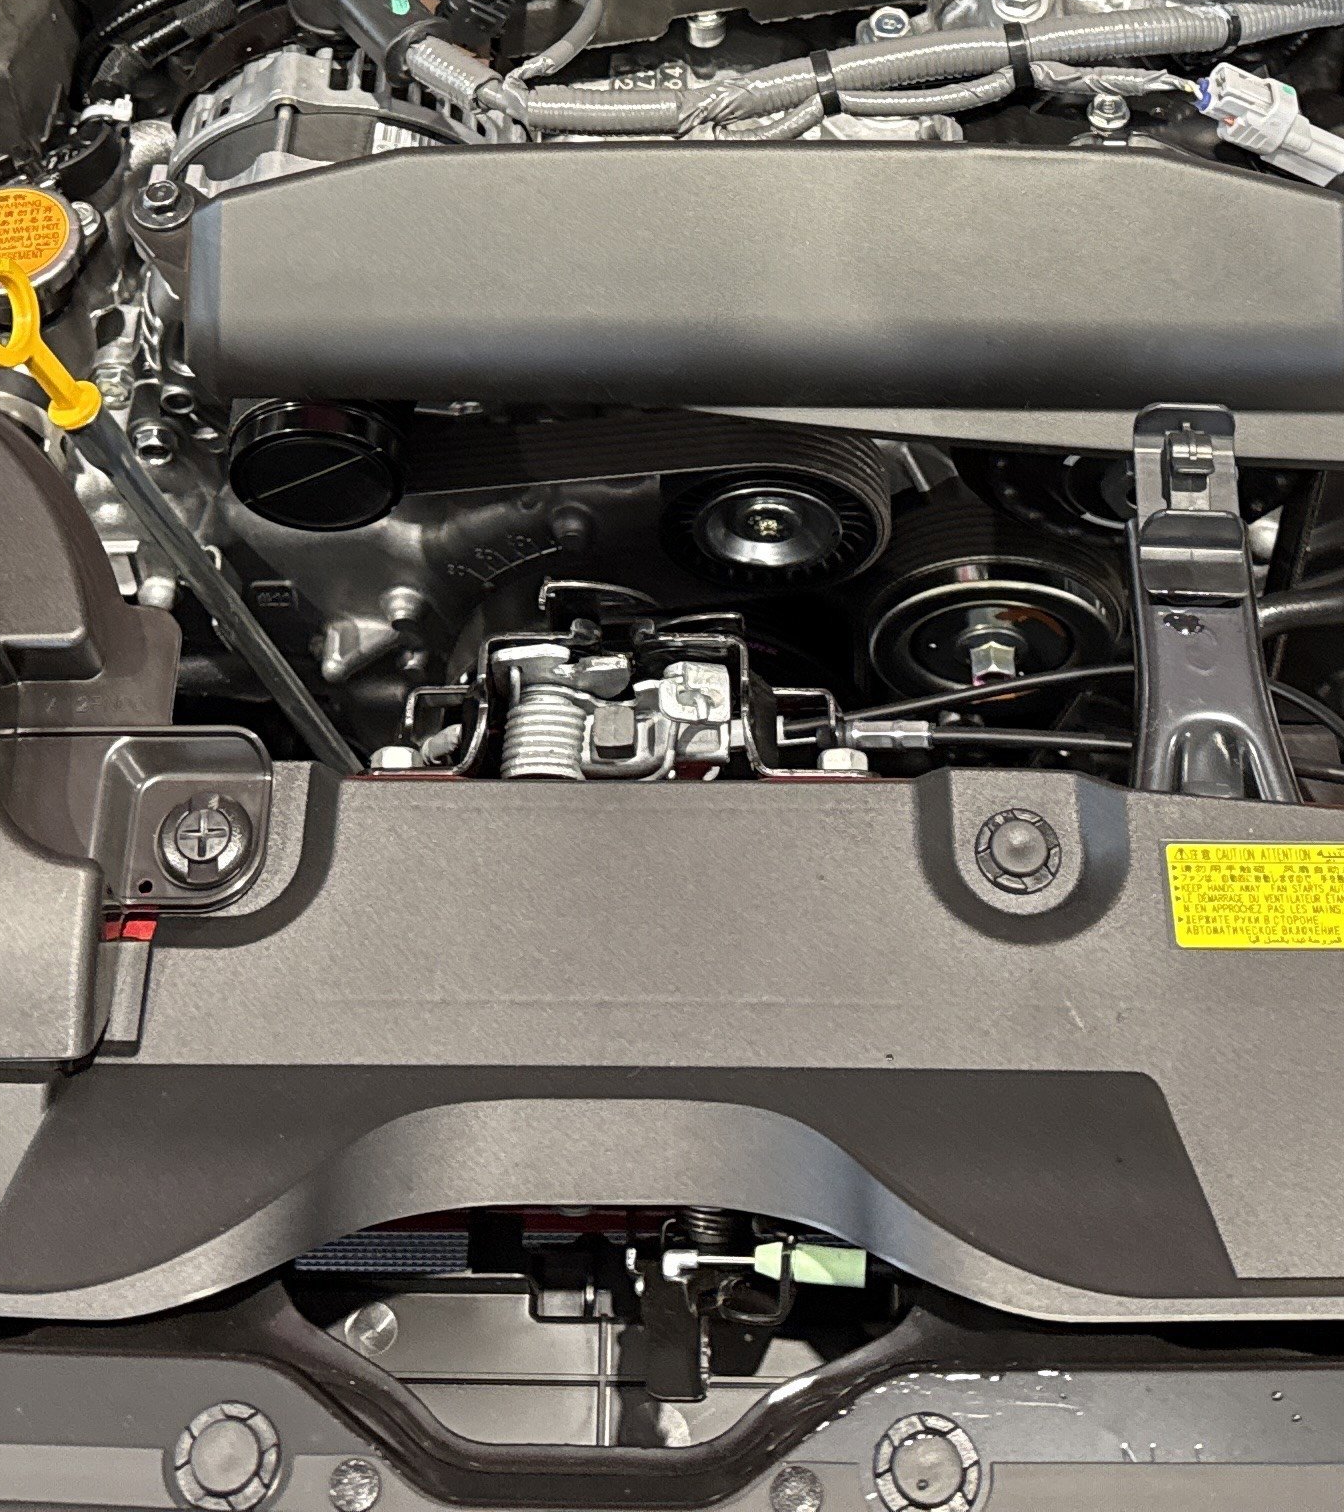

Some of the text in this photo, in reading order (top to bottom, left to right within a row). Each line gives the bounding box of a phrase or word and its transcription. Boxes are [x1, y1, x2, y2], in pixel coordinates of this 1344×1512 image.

[12, 225, 39, 234] WHEN
[1215, 848, 1311, 862] CAUTION ATTENTION
[1181, 884, 1202, 893] KEEP
[1207, 884, 1235, 893] HANDS
[1270, 885, 1288, 893] FAN
[1292, 884, 1325, 893] STARTS
[1183, 894, 1193, 903] LE
[1197, 892, 1242, 903] DÉMARRAGE
[1248, 894, 1260, 903] DU
[1264, 894, 1321, 904] VENTILATEUR
[1212, 904, 1262, 914] APPROCHEZ
[1267, 904, 1285, 914] PAS
[1290, 904, 1308, 914] LES
[1186, 915, 1230, 925] ДЕРЖИТЕ
[1234, 915, 1260, 925] РУКИ
[1186, 925, 1277, 936] АВТОМАТИЧЕСКОЕ
[1281, 925, 1341, 936] ВКЛЮЧЕНИЕ
